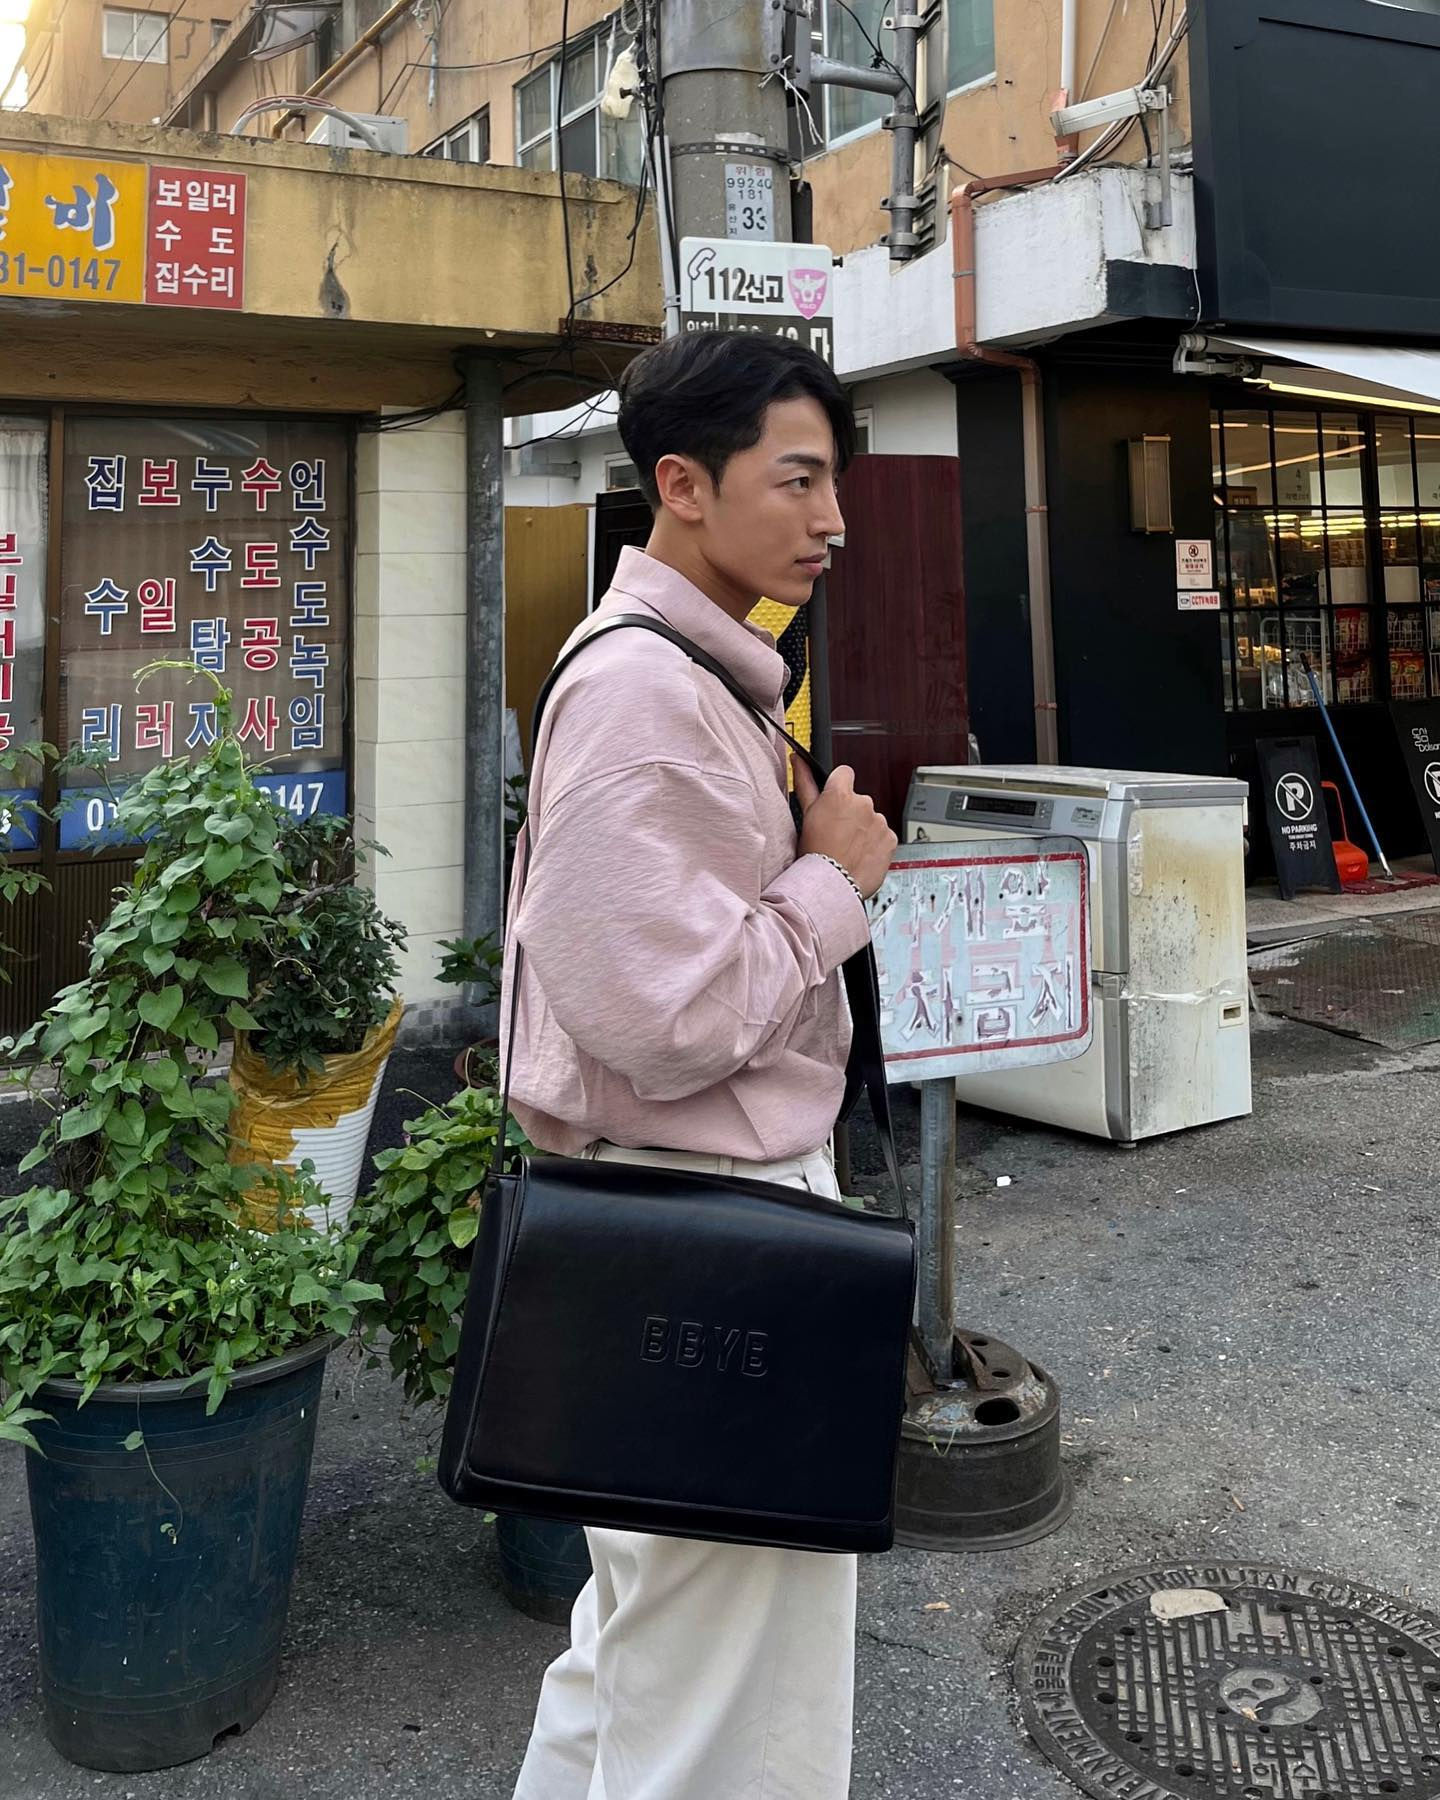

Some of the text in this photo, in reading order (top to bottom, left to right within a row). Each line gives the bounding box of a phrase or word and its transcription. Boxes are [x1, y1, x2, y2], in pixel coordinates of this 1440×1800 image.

[155, 179, 236, 215] 보일러
[154, 262, 235, 298] 집수리
[1281, 824, 1318, 834] NO PARKING
[1289, 840, 1317, 851] 주차금지
[880, 952, 1075, 1045] 차금지
[1108, 1567, 1299, 1604] METROPOLITAN
